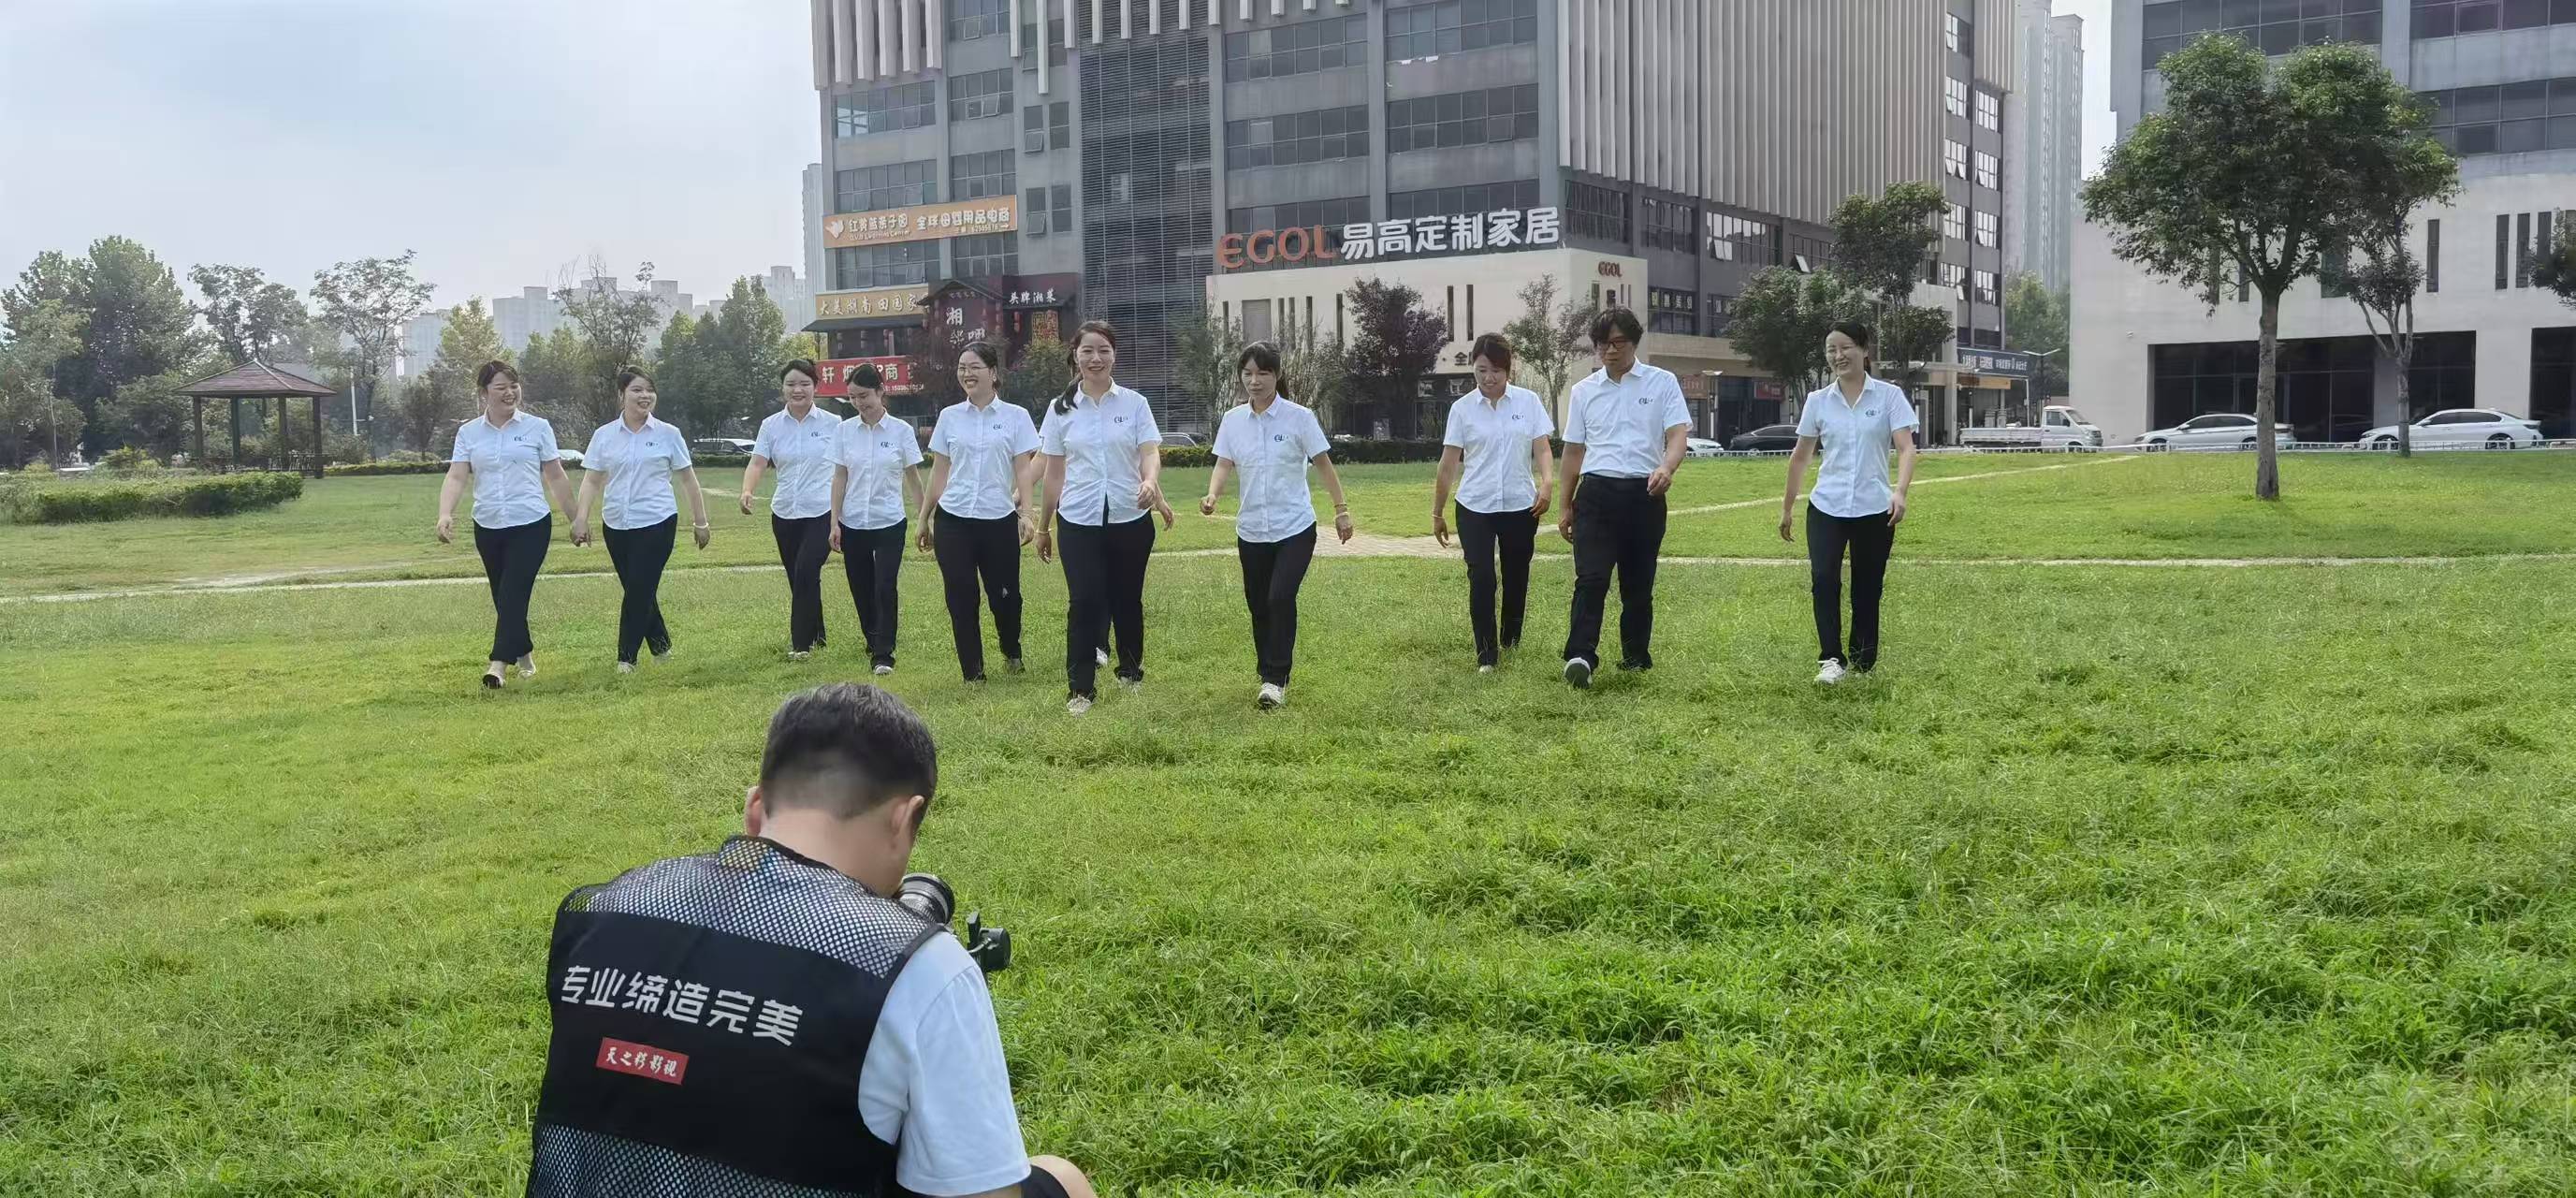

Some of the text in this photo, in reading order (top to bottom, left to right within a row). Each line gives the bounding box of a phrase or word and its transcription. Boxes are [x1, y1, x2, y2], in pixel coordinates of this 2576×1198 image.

[1217, 206, 1561, 269] EGOL 易高定制家居
[561, 965, 804, 1046] 专业缔造完美
